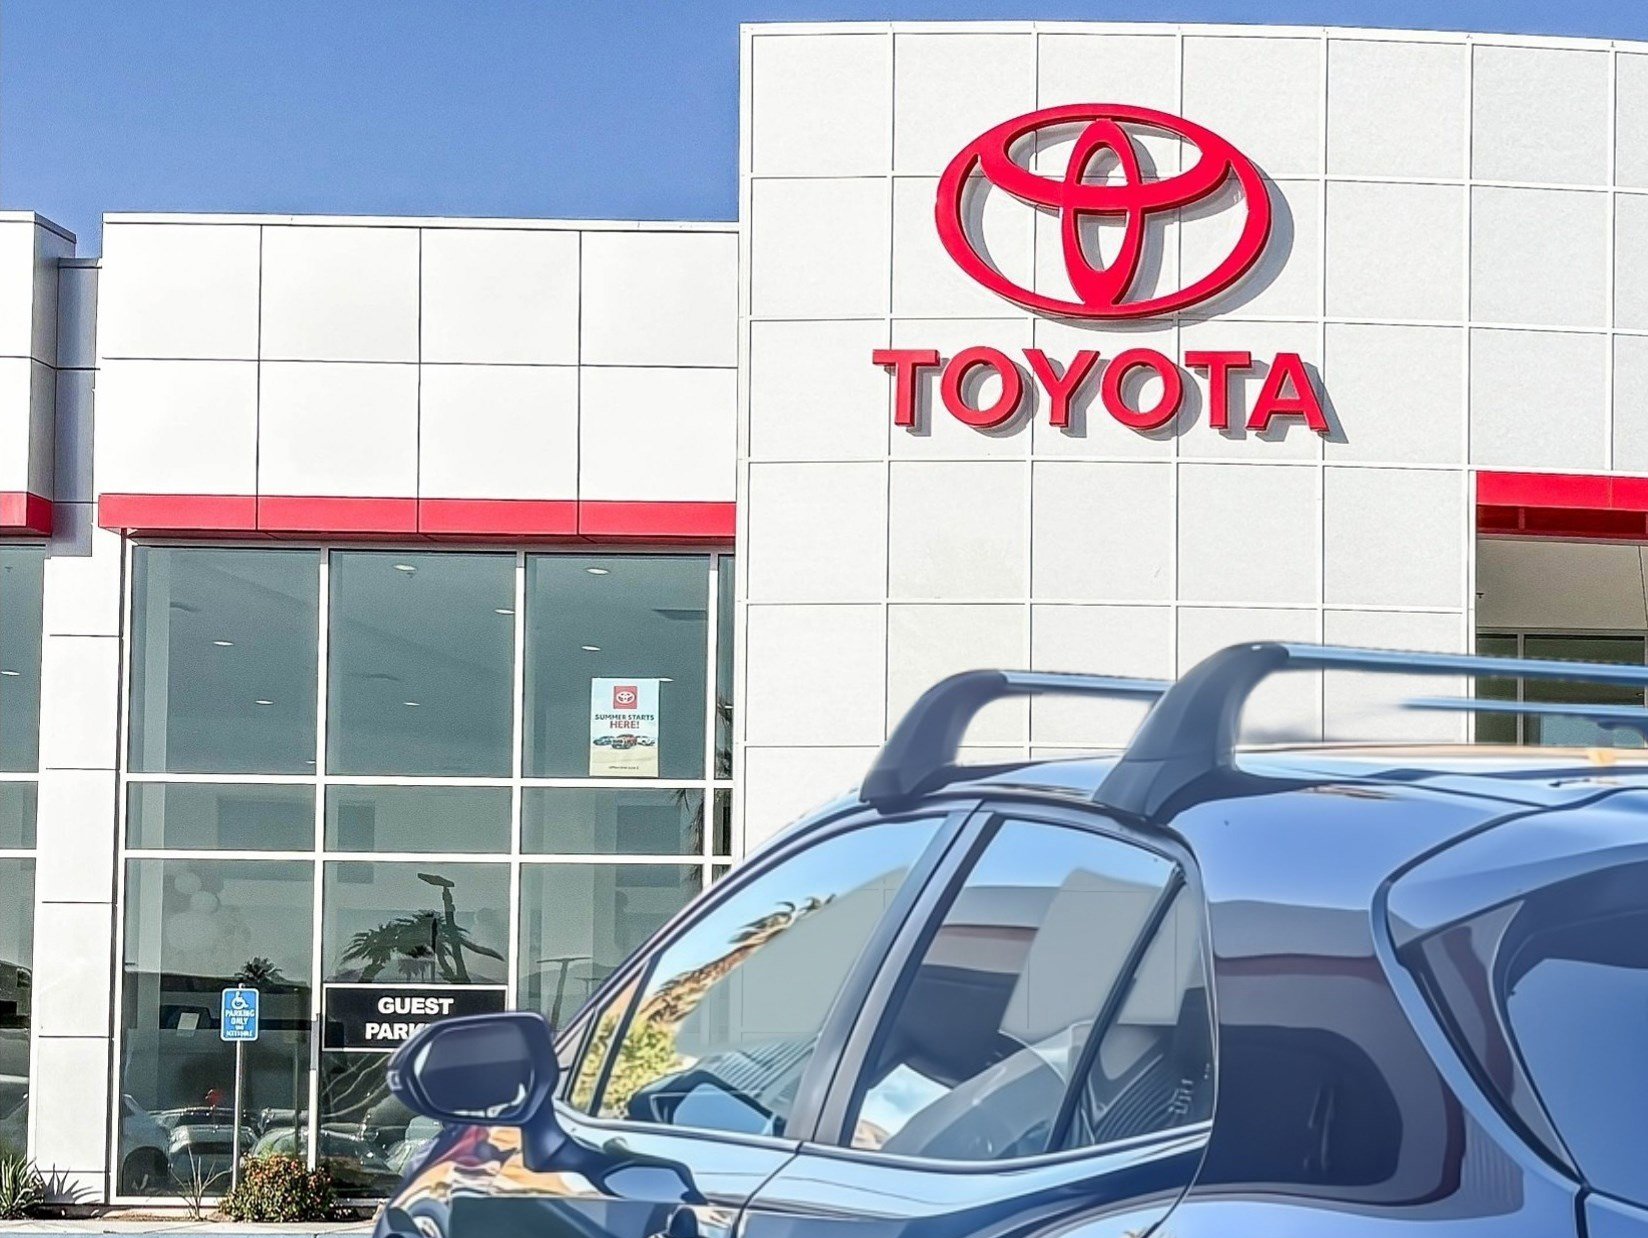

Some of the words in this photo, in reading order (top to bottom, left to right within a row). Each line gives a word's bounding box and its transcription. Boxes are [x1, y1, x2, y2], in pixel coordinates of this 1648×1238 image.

[873, 345, 1330, 432] TOYOTA
[609, 720, 640, 729] HERE!
[377, 997, 455, 1015] GUEST
